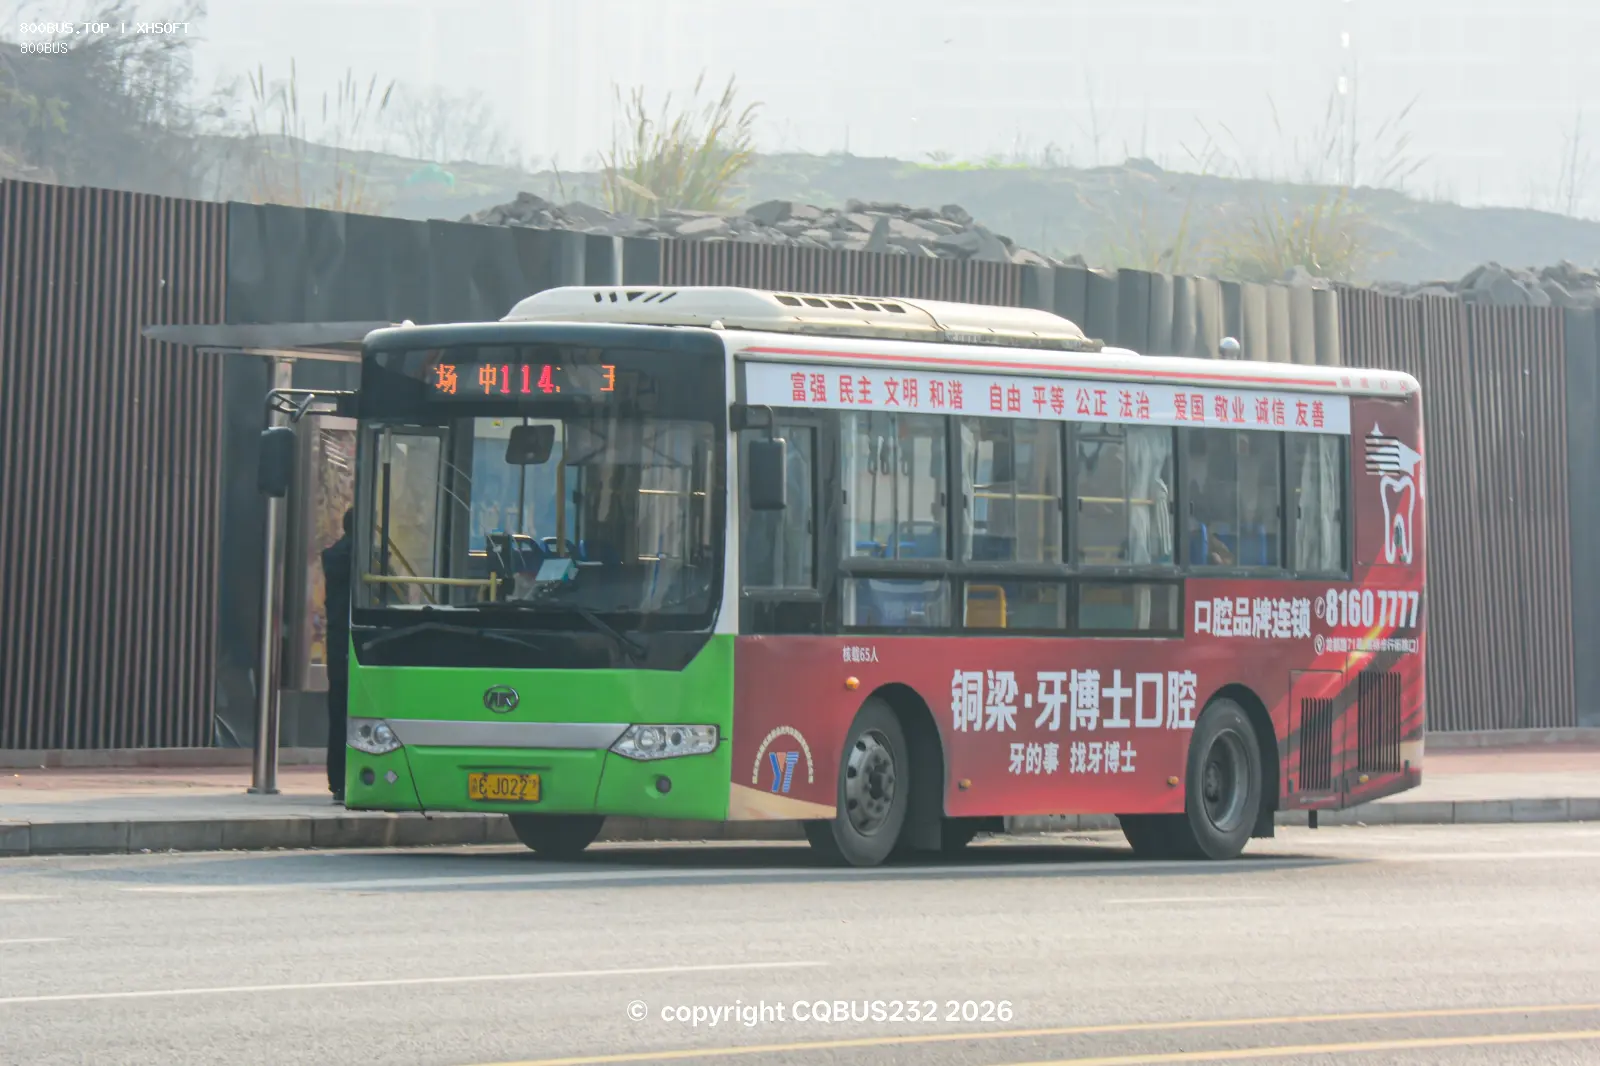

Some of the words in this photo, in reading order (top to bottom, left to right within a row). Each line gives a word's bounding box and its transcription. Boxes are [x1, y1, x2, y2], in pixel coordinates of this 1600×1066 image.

[790, 372, 827, 402] 富强
[839, 375, 873, 404] 民主
[884, 377, 918, 408] 文明
[929, 380, 963, 410] 和谐
[990, 383, 1021, 412] 自由
[1032, 386, 1065, 415] 平等
[1075, 388, 1108, 416] 公正
[1119, 391, 1150, 419] 法治
[1174, 393, 1205, 421] 爱国
[1214, 395, 1246, 423] 敬业
[1255, 398, 1286, 425] 诚信
[1295, 401, 1325, 428] 友善
[1194, 596, 1311, 639] 口腔品牌连锁
[1325, 588, 1374, 628] 8160
[1377, 590, 1419, 628] 7777
[951, 669, 1197, 732] 铜梁·牙博士口腔
[1008, 742, 1059, 775] 牙的事
[1069, 741, 1137, 774] 找牙博士
